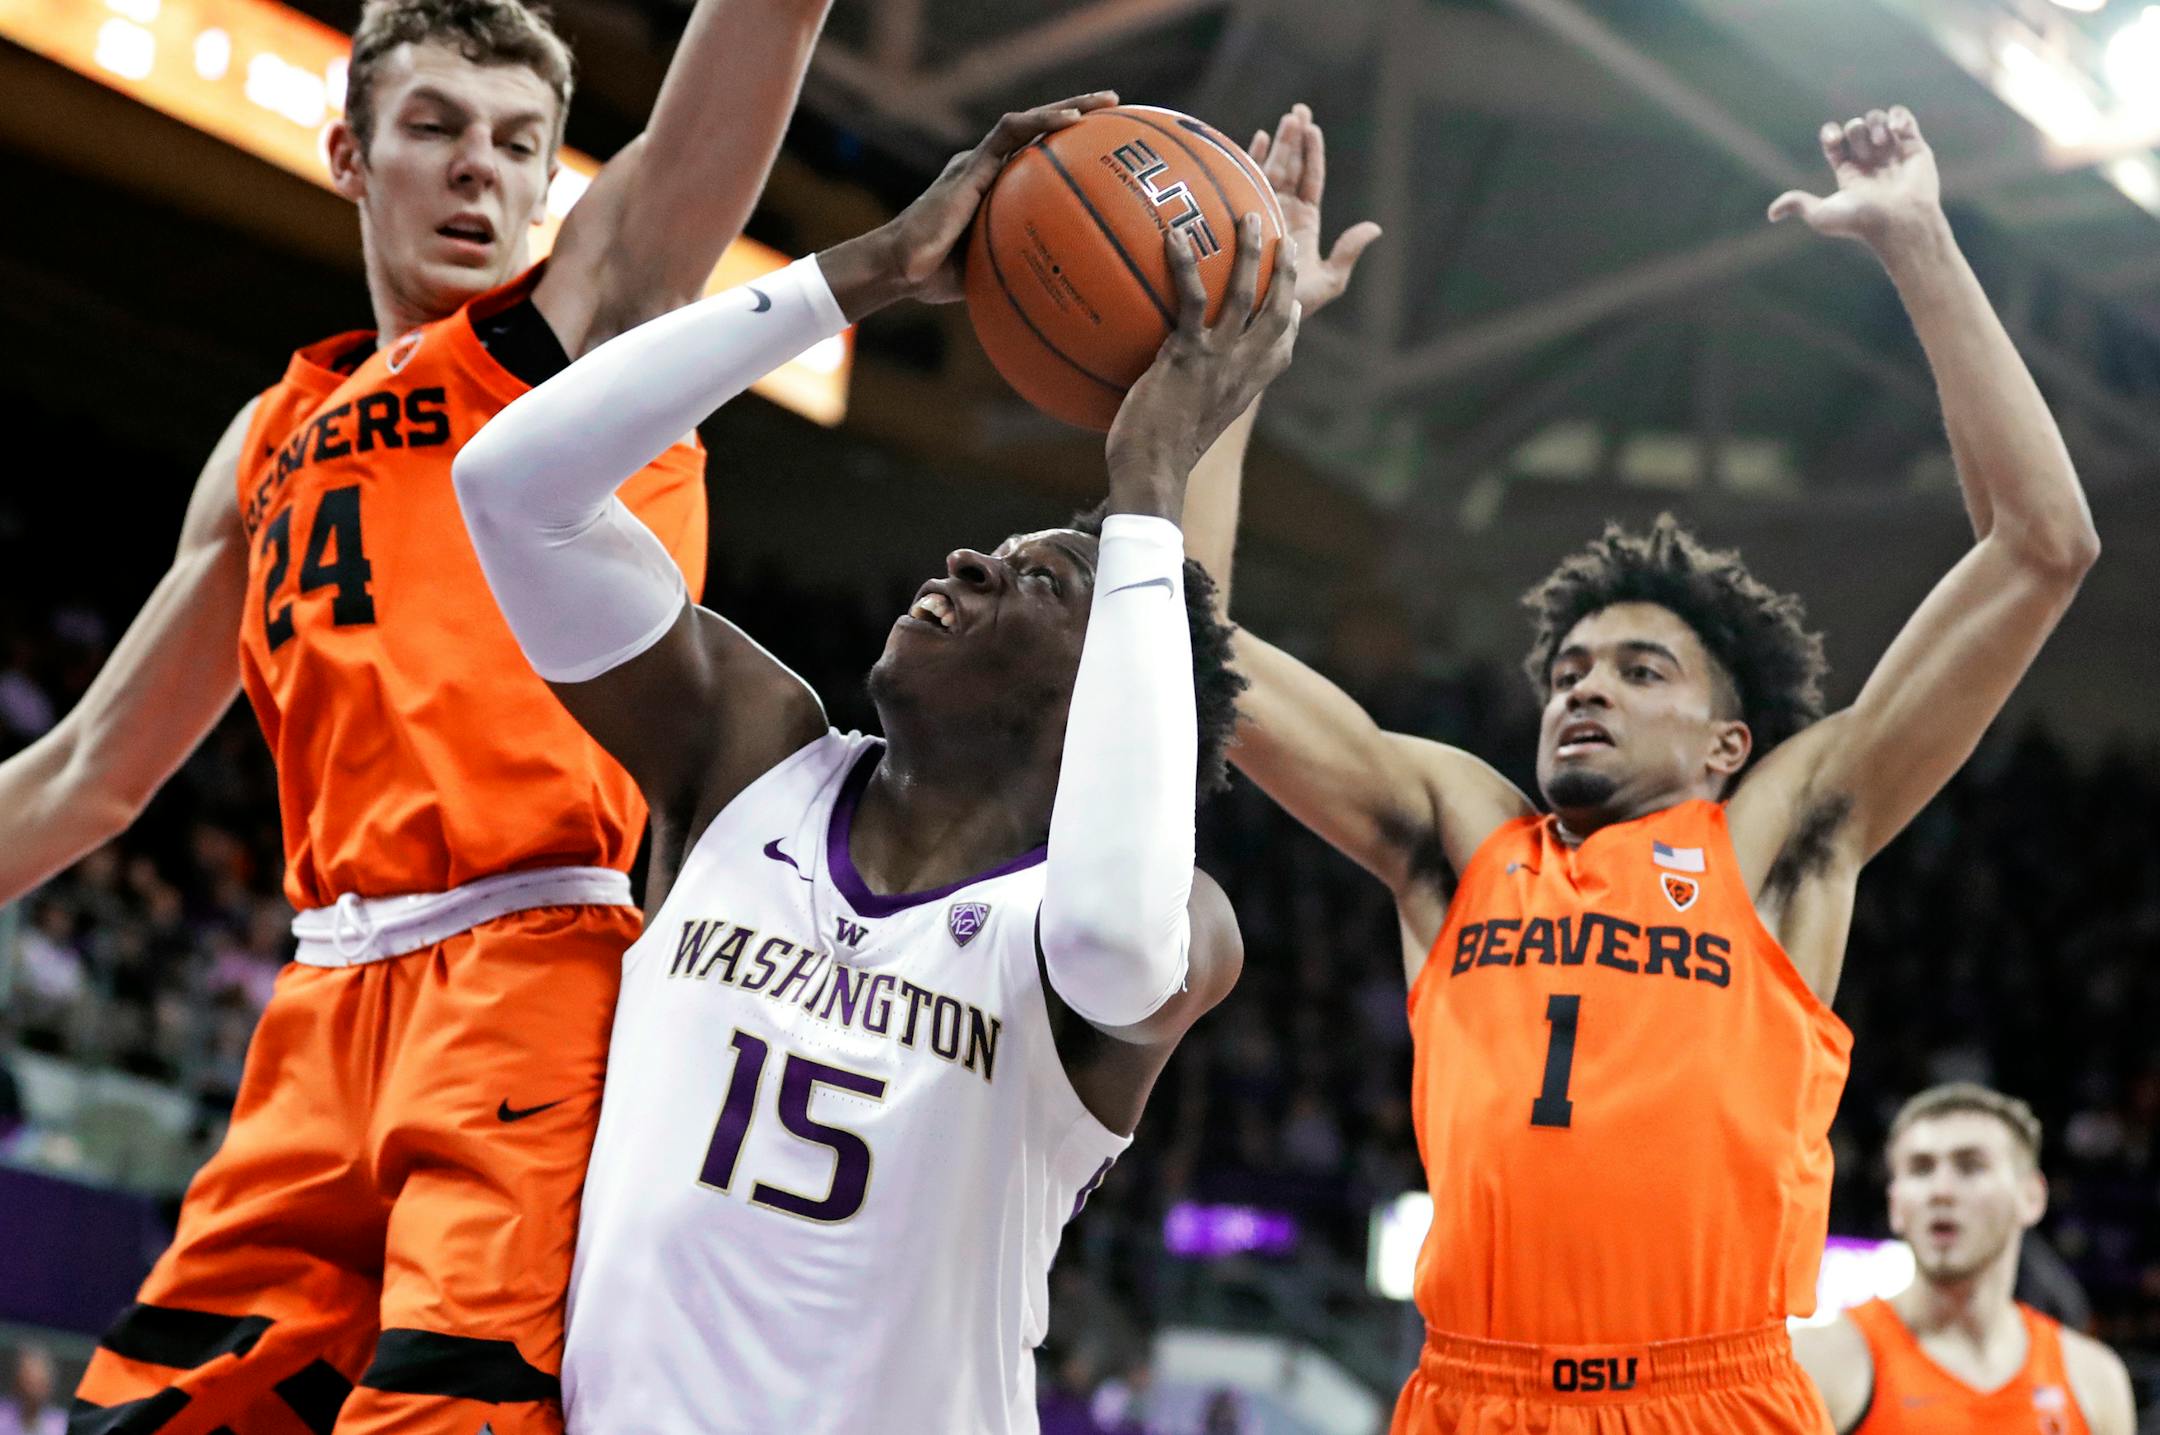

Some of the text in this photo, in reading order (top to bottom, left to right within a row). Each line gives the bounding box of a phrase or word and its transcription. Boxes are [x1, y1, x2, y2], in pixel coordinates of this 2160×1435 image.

[1111, 138, 1221, 260] ELITE
[259, 484, 376, 654] 24
[836, 916, 869, 948] W
[954, 918, 974, 936] 12
[1450, 912, 1731, 988] BEAVERS
[668, 919, 1002, 1084] WASHINGTON
[1530, 994, 1580, 1129] 1
[696, 1025, 889, 1225] 15
[1552, 1357, 1638, 1392] OSU
